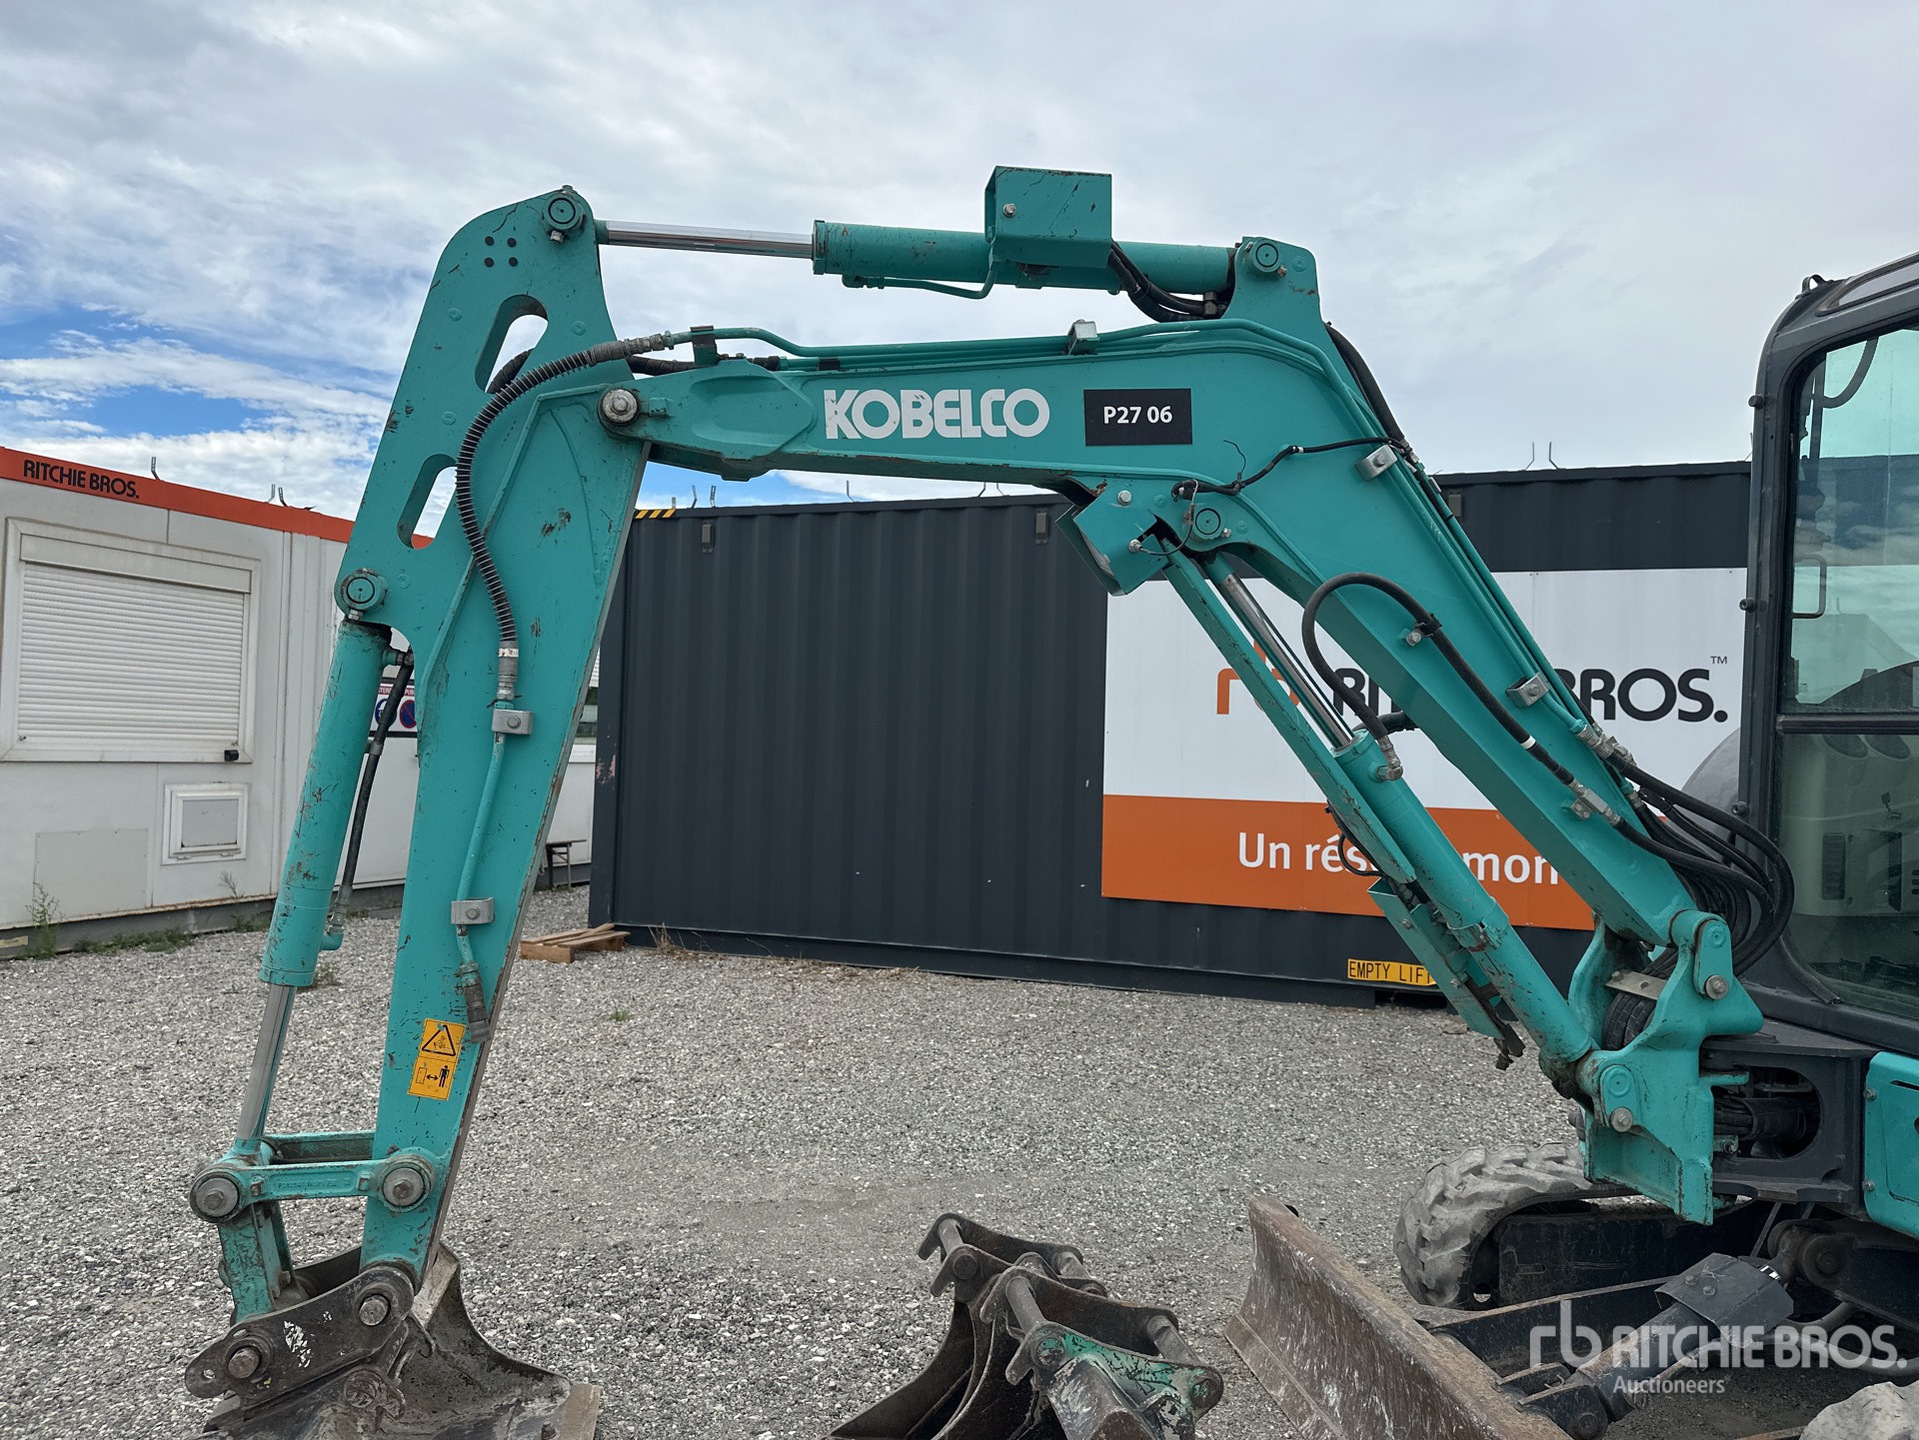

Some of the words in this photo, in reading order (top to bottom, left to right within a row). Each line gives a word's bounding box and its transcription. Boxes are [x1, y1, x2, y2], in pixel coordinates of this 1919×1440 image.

[823, 388, 1050, 439] KOBELCO
[1103, 405, 1140, 424] P27
[1146, 405, 1173, 423] 06
[23, 459, 86, 488] RITCHIE
[89, 473, 139, 499] BROS.
[1710, 655, 1728, 665] TM
[1238, 832, 1291, 869] Un
[1305, 834, 1380, 874] rés
[1462, 852, 1558, 885] mon
[1349, 961, 1391, 980] EMPTY
